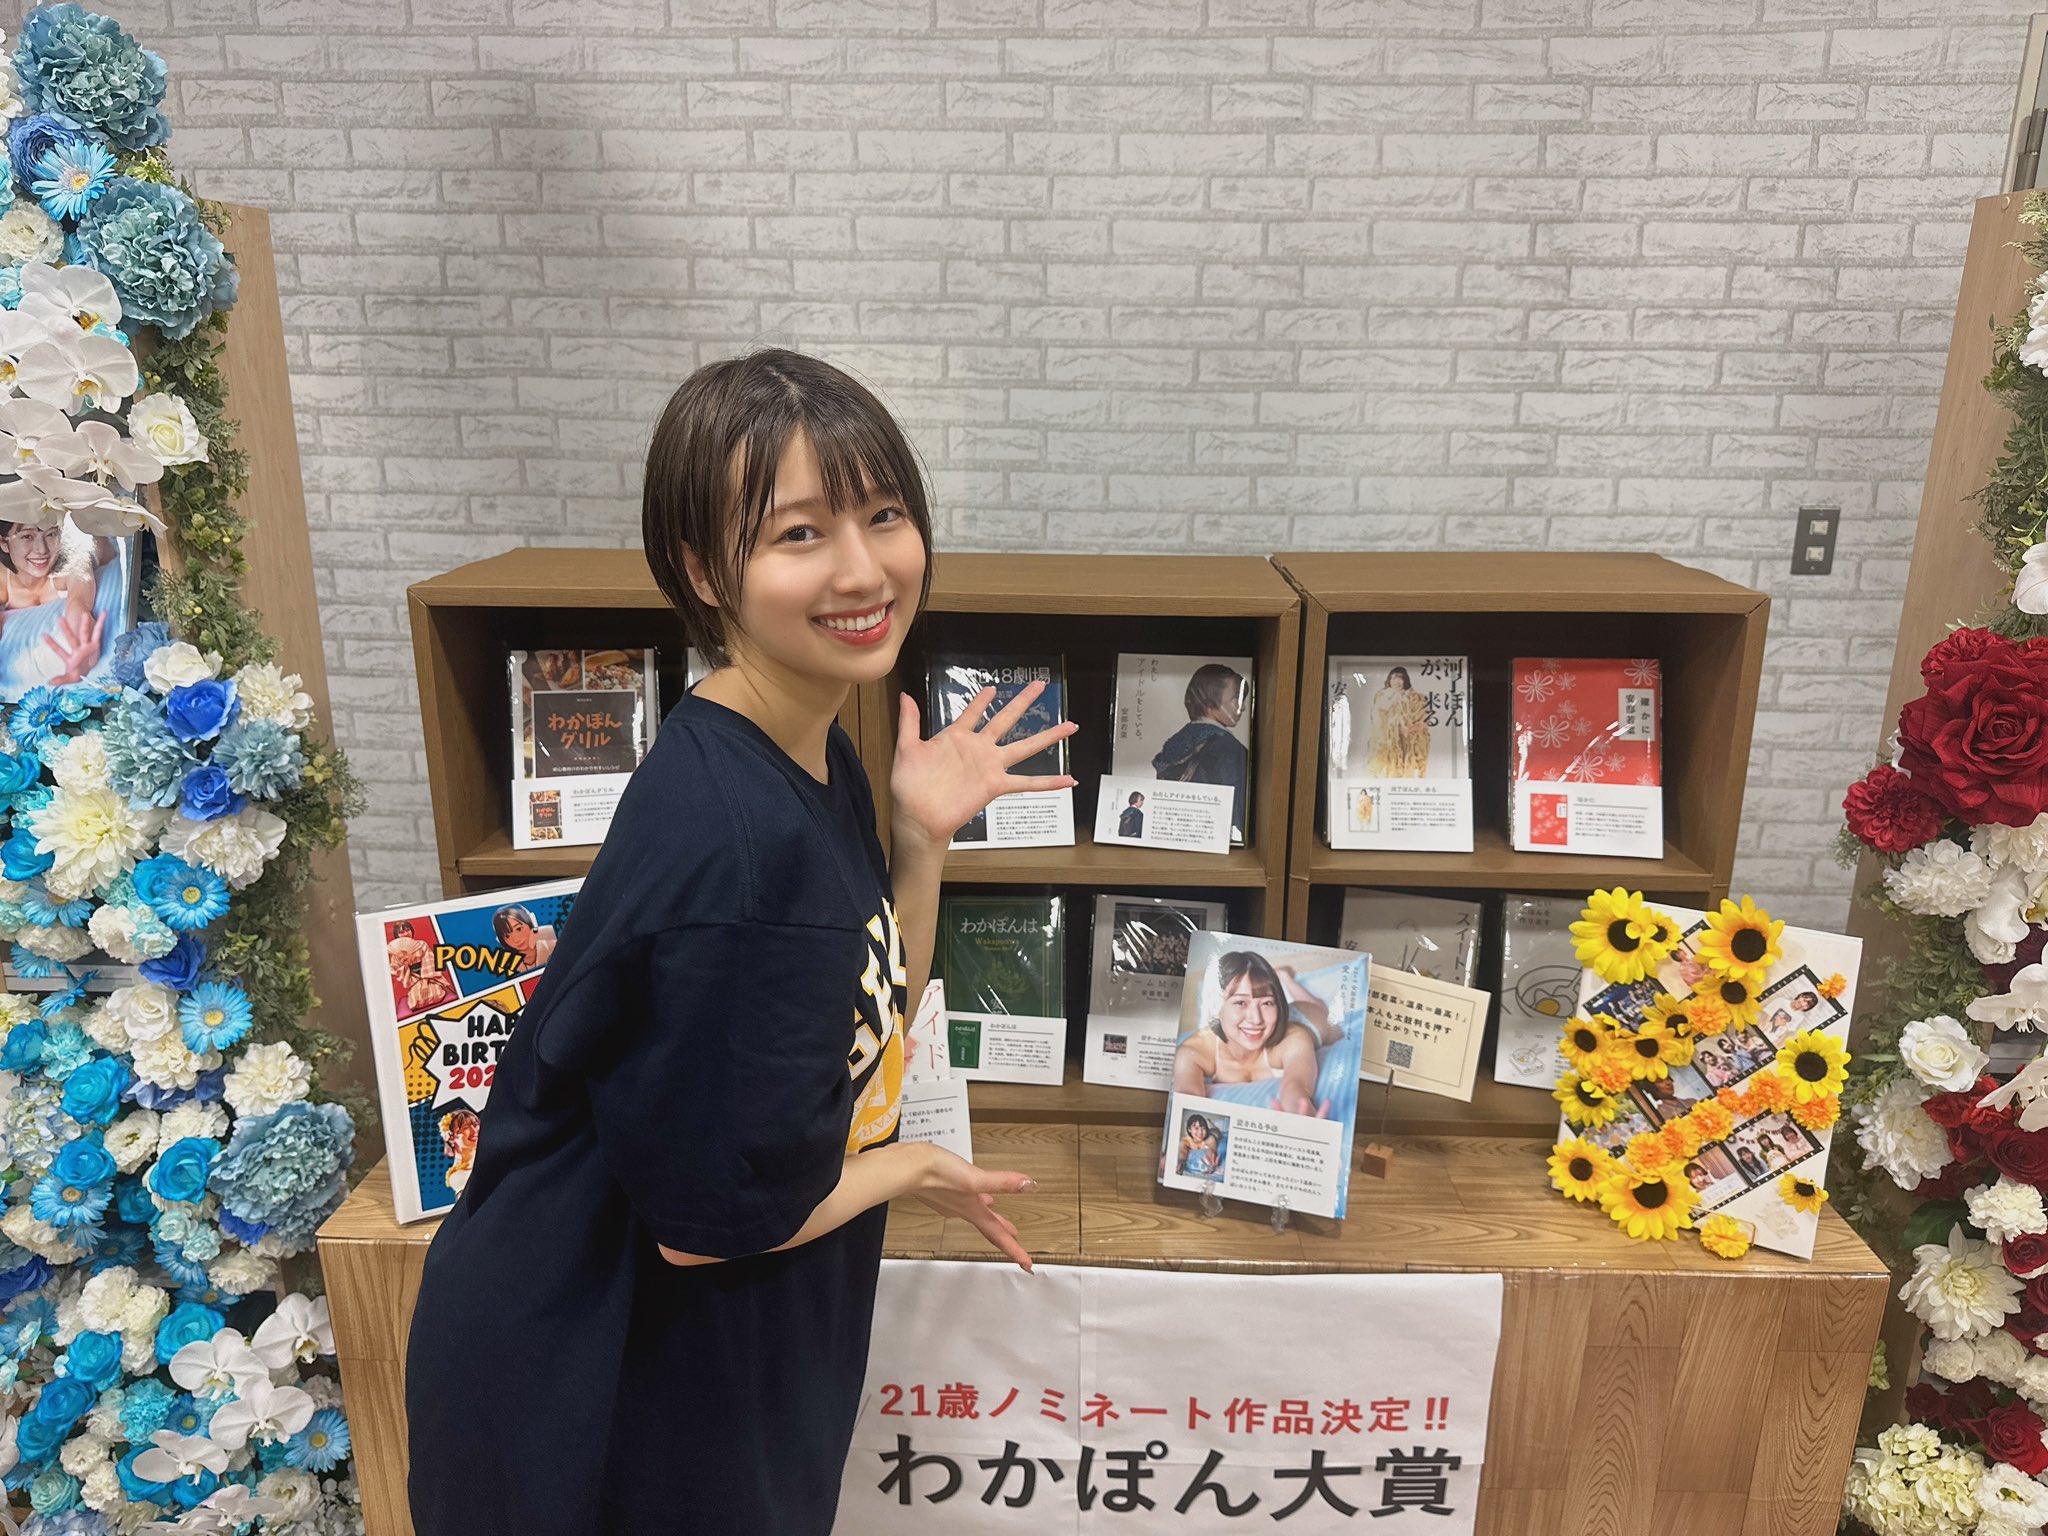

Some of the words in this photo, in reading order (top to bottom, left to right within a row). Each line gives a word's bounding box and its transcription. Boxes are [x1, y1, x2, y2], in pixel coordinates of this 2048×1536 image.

[548, 711, 624, 732] わかぽん
[1640, 696, 1651, 735] 確かに
[560, 730, 612, 751] グリル
[959, 917, 1038, 934] わかぽんは
[436, 944, 524, 977] PON!!
[1367, 988, 1467, 1024] 部若菜×温泉=最高!」
[467, 1013, 521, 1038] HAP
[919, 984, 945, 1084] アイド
[1373, 1019, 1438, 1044] 仕上がりです!
[443, 1040, 509, 1067] BIRT
[448, 1064, 497, 1090] 202
[879, 1382, 1451, 1436] 21歳ノミネート作品決定!!
[875, 1433, 1462, 1522] わかぽん大賞
